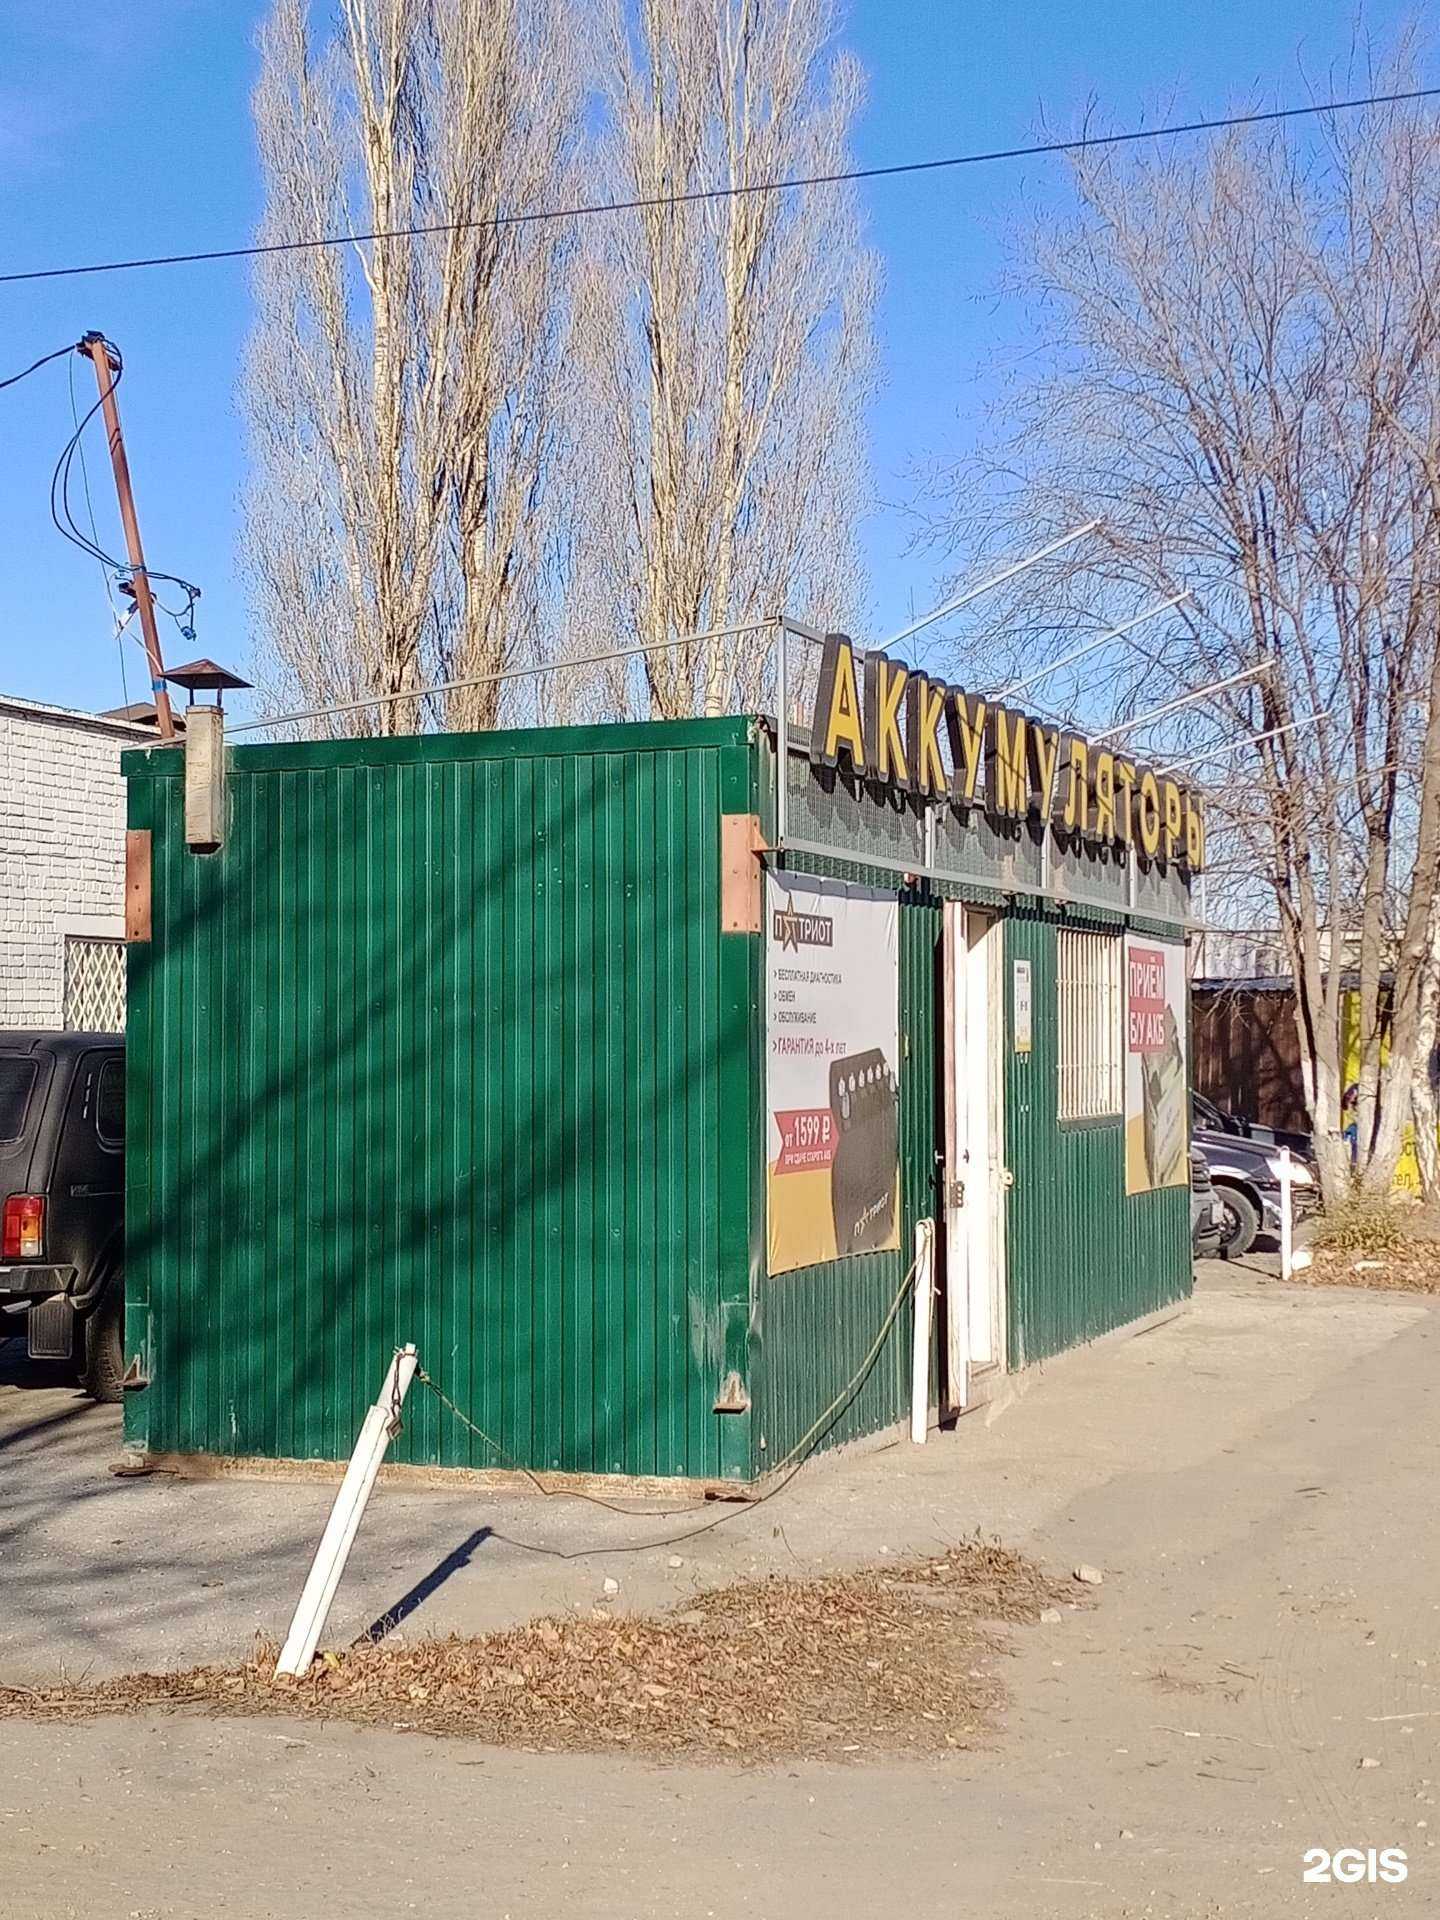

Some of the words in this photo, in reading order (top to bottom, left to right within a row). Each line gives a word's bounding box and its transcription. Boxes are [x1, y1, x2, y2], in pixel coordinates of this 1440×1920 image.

[815, 637, 1206, 873] АККУМУЛЯТОРЫ
[810, 970, 842, 984] ДИАГНОСТИКА
[1129, 957, 1165, 1000] ПРИЁМ
[777, 990, 796, 1003] ОБМЕН
[777, 1010, 817, 1026] ОБСЛУЖИВАНИЕ
[1129, 1011, 1146, 1045] Б/У
[1146, 1012, 1165, 1046] АКБ
[777, 1037, 814, 1055] ГАРАНТИЯ
[815, 1042, 825, 1057] до
[825, 1038, 835, 1055] 4-х
[835, 1042, 847, 1054] лет
[784, 1133, 793, 1148] от
[794, 1115, 820, 1147] 1599
